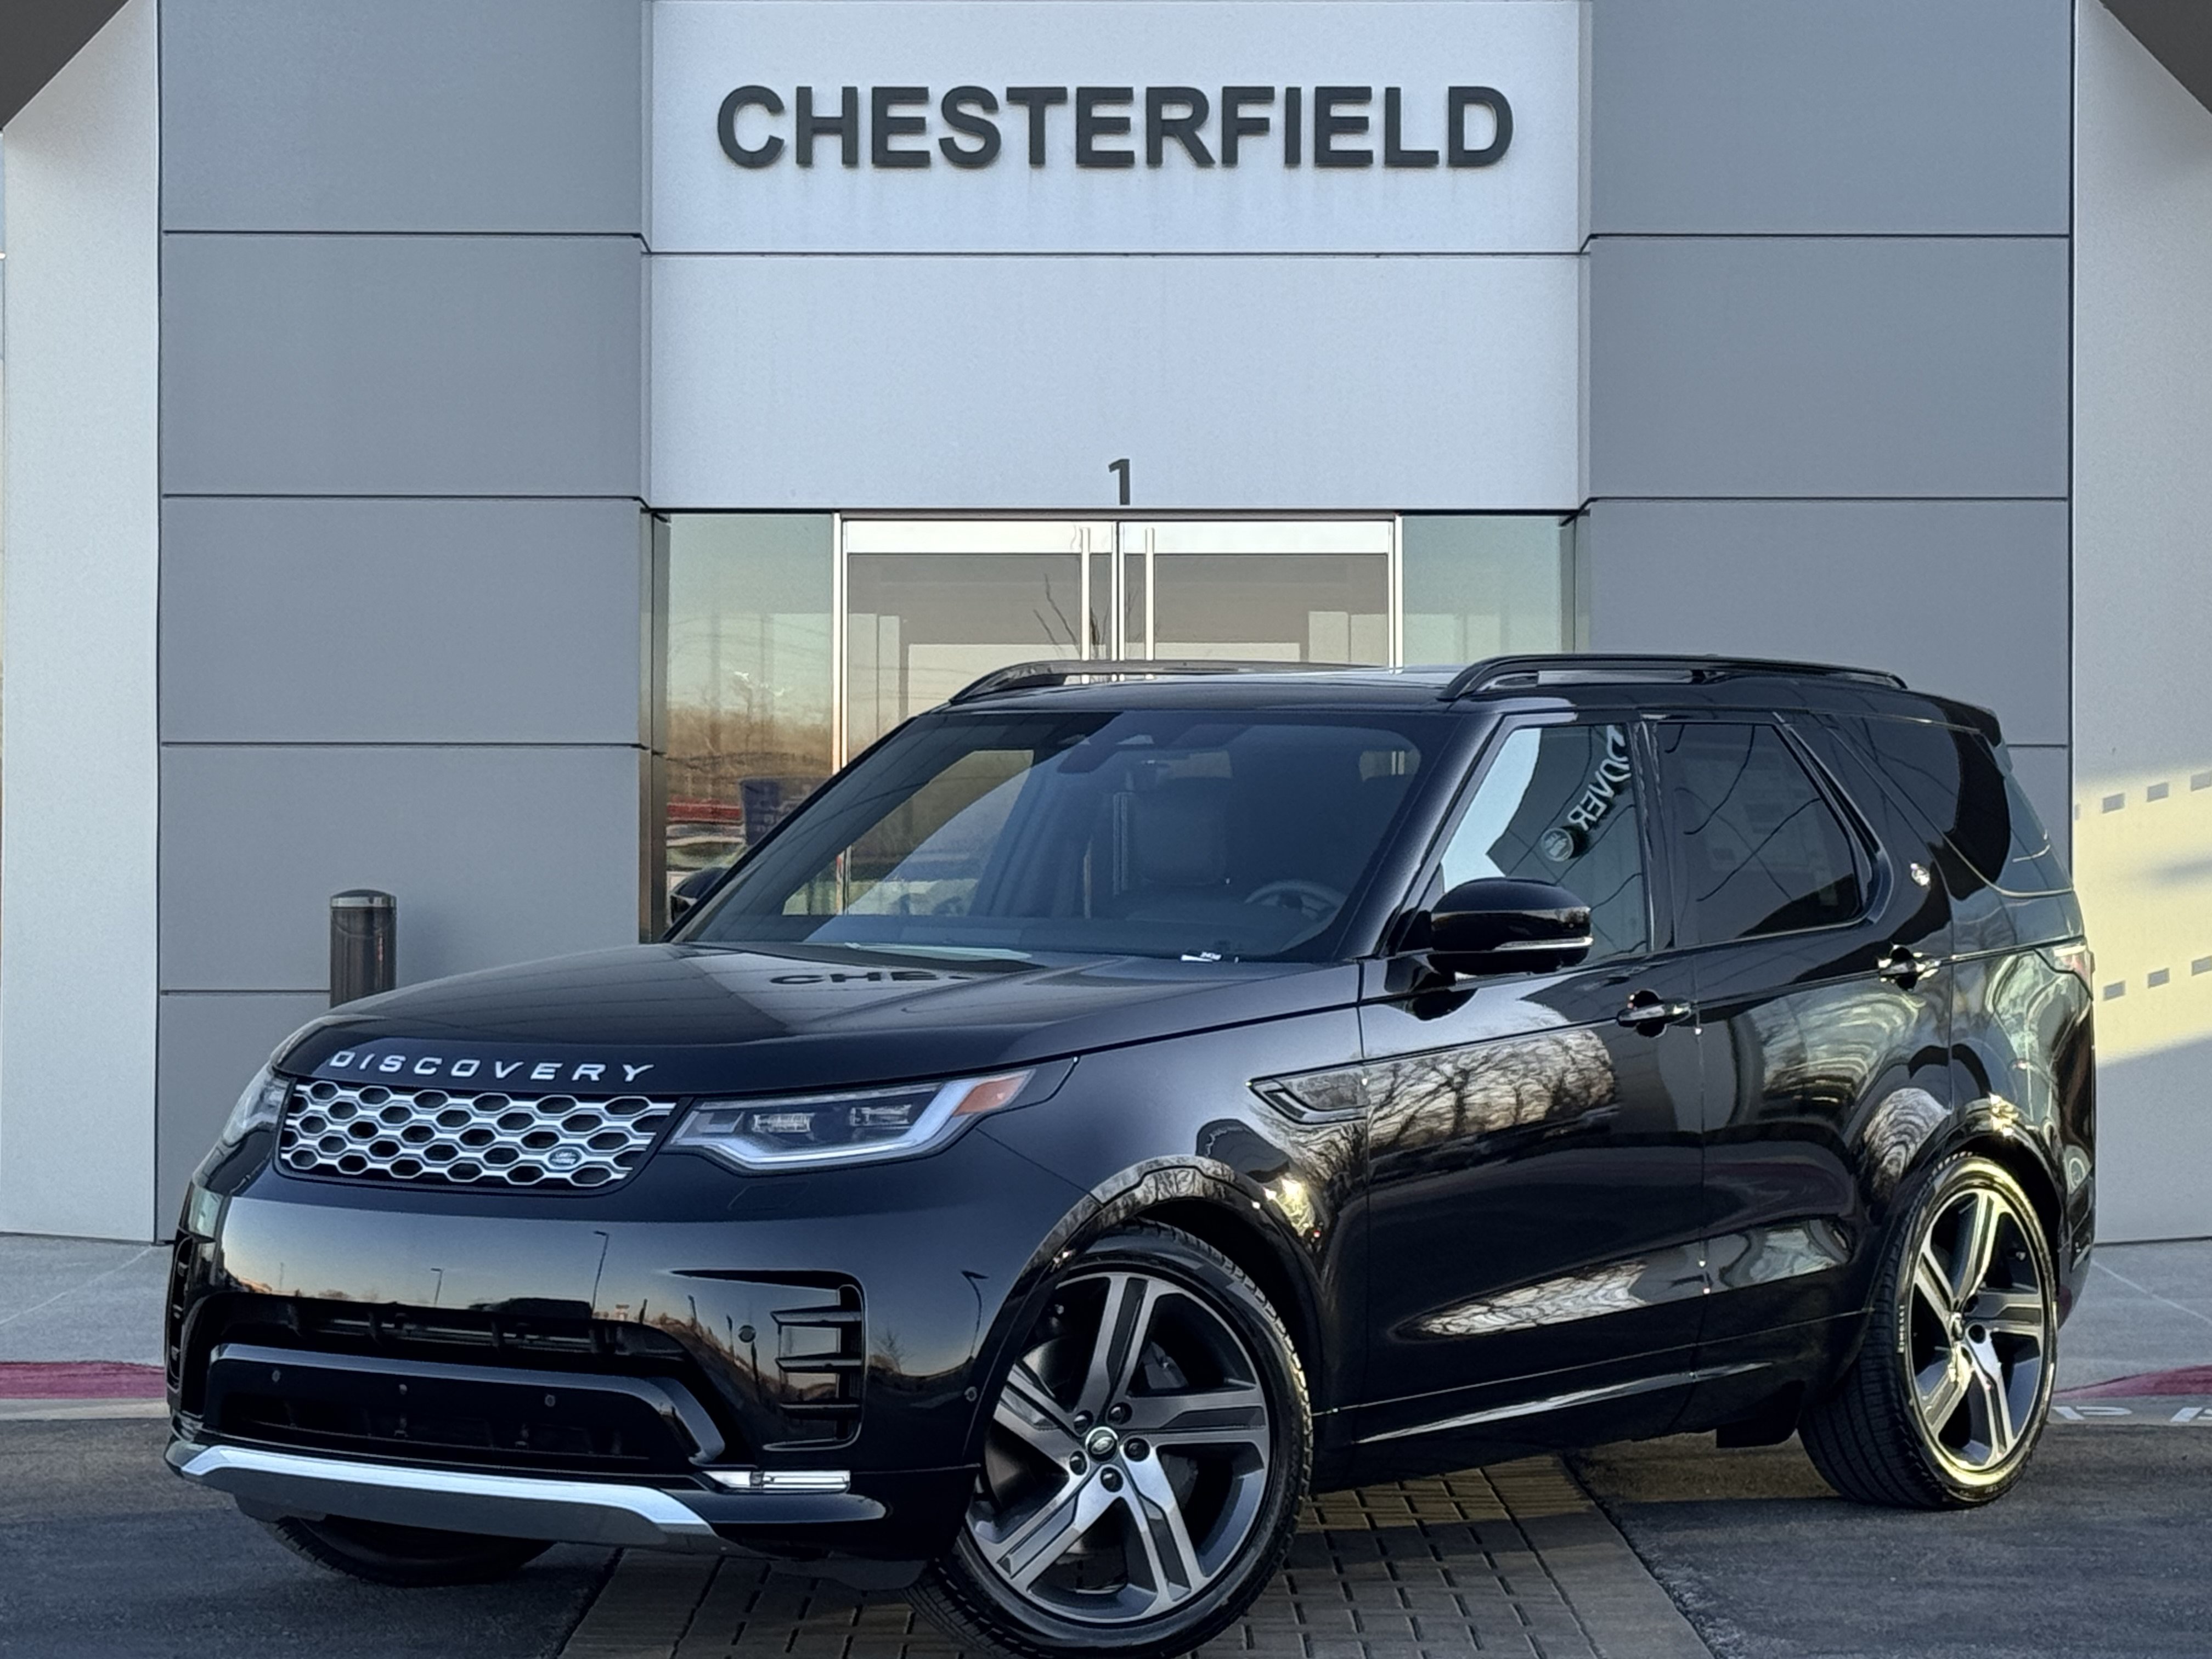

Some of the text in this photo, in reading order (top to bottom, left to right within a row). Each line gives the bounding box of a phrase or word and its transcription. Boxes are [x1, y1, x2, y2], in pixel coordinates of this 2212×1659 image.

[718, 85, 1514, 169] CHESTERFIELD
[1108, 458, 1130, 506] 1
[329, 1050, 653, 1081] DISCOVERY
